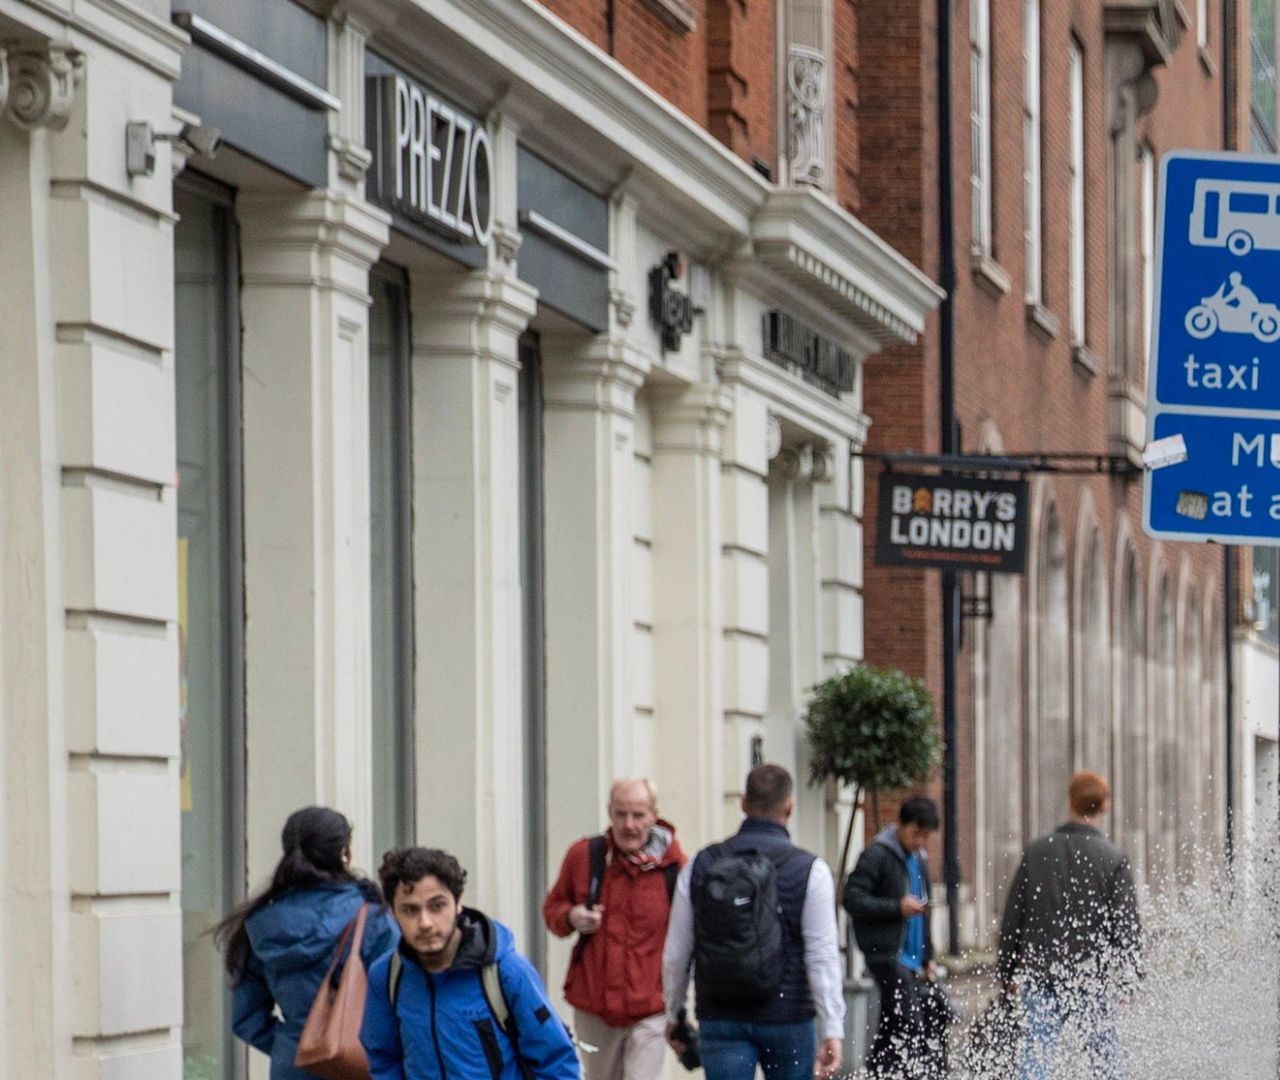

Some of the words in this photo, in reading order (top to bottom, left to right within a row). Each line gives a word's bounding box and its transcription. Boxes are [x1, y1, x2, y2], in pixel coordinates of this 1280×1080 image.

[395, 74, 495, 247] PREZZO
[1184, 354, 1260, 391] taxi
[1211, 485, 1253, 518] at
[890, 514, 1015, 551] LONDON
